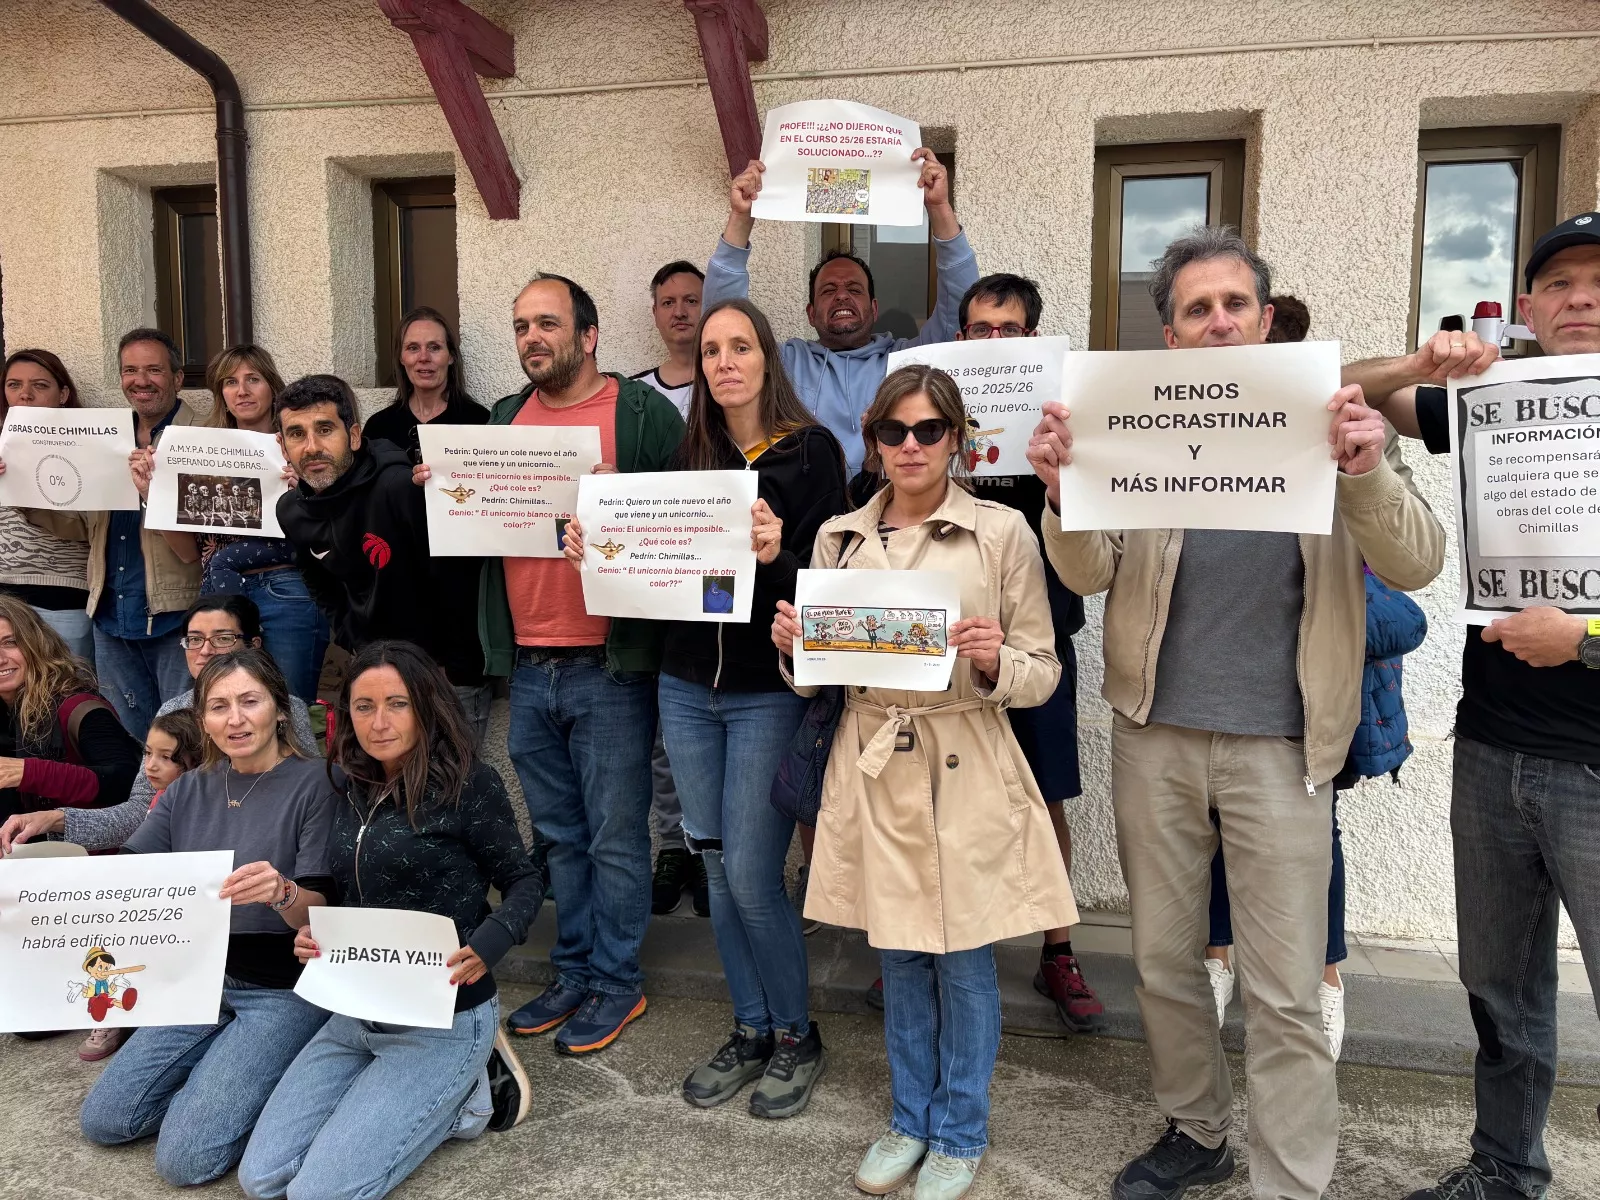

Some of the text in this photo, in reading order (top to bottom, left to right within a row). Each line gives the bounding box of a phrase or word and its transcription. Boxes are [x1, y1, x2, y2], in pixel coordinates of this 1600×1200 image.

[780, 122, 814, 131] PROFE!!!
[846, 123, 883, 131] DIJERON
[886, 127, 902, 135] QUE
[866, 137, 901, 145] ESTARÍA
[798, 148, 882, 157] SOLUCIONADO...??
[963, 366, 1017, 377] asegurar
[1020, 365, 1042, 375] que
[982, 382, 1033, 394] 2025/26
[1155, 383, 1239, 400] MENOS
[991, 403, 1039, 412] nuevo...
[1470, 402, 1501, 427] SE
[1109, 412, 1286, 430] PROCRASTINAR
[9, 425, 32, 433] OBRAS
[34, 426, 56, 434] COLE
[221, 448, 264, 457] CHIMILLAS
[1188, 445, 1202, 460] Y
[1489, 450, 1600, 465] Se recompensará
[167, 457, 215, 467] ESPERANDO
[50, 475, 65, 486] 0%
[1112, 473, 1285, 492] MÁS INFORMAR
[1487, 471, 1549, 483] cualquiera
[1554, 471, 1578, 481] que
[1484, 486, 1597, 502] algo del estado de
[626, 498, 650, 506] Quiero
[1497, 507, 1528, 516] obras
[1532, 506, 1551, 515] del
[1555, 505, 1583, 514] cole
[1519, 523, 1578, 533] Chimillas
[639, 538, 658, 546] ¿Qué
[1478, 568, 1507, 599] SE
[18, 886, 196, 903] Podemos asegurar que
[31, 908, 183, 925] en el curso 2025/26
[22, 934, 190, 949] habrá edificio nuevo...
[406, 950, 442, 966] YA!!!
